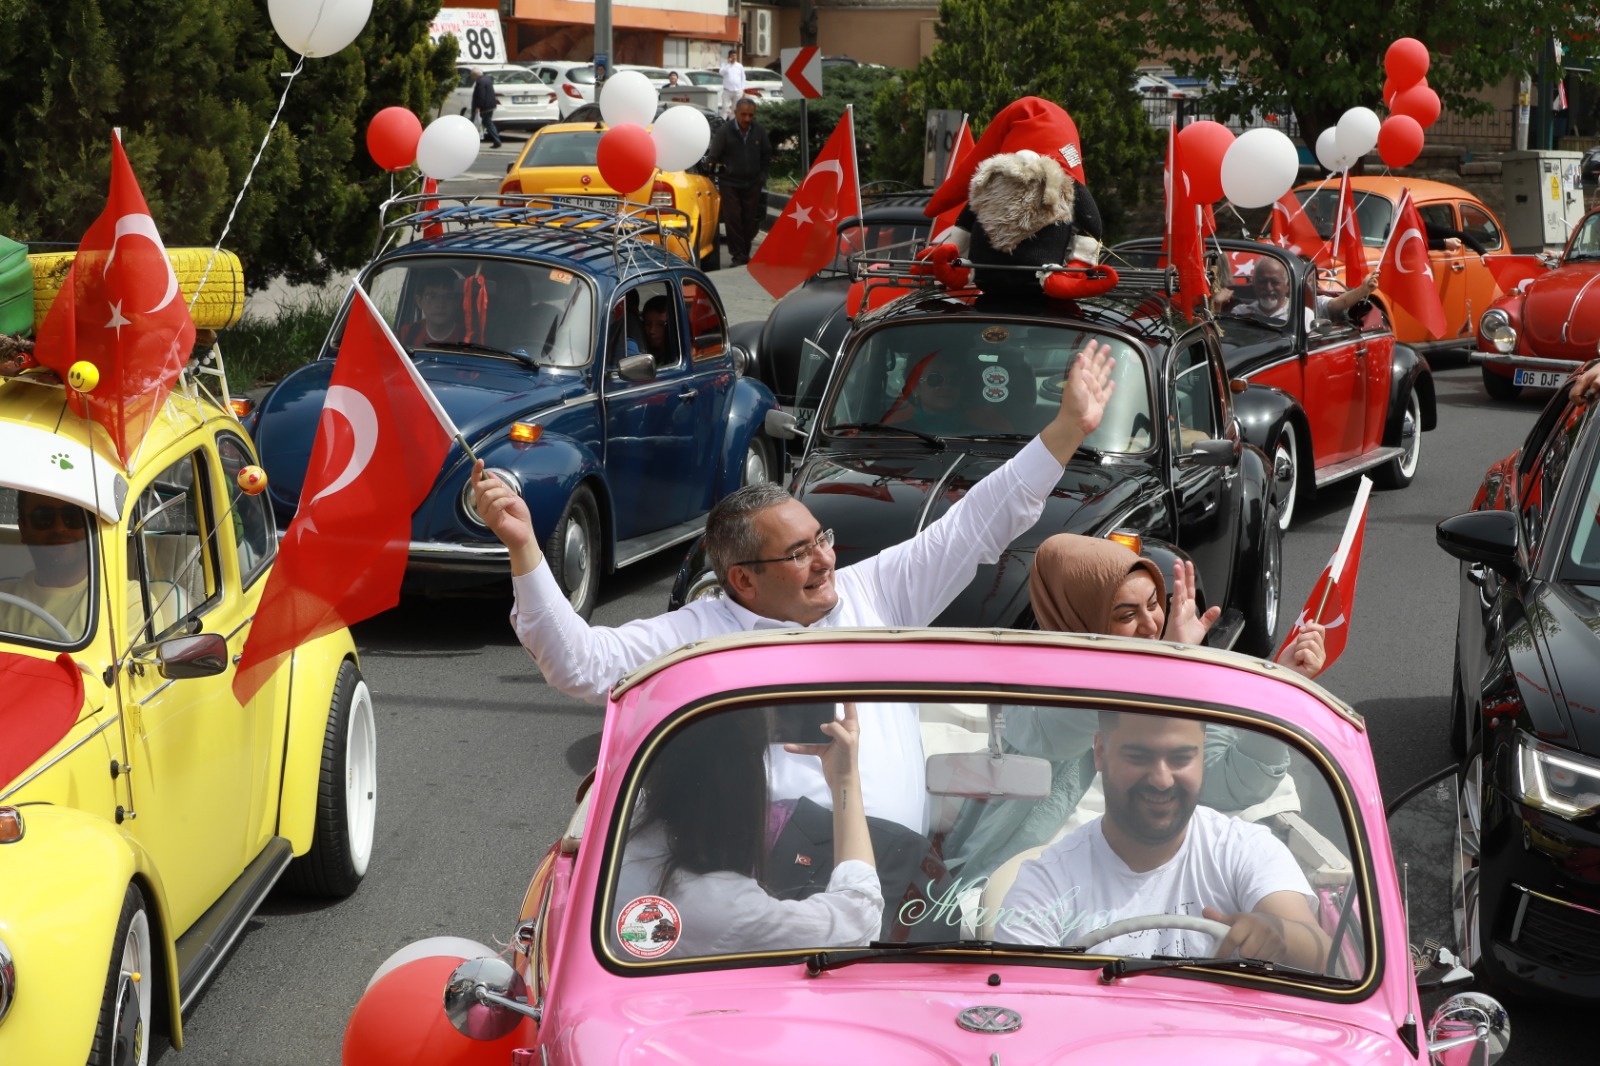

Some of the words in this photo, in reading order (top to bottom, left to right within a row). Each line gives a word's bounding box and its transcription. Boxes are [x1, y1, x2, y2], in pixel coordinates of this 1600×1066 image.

[466, 28, 496, 60] 89
[1522, 372, 1535, 385] 06
[1541, 373, 1560, 386] DJF
[899, 876, 1112, 946] Manolya
